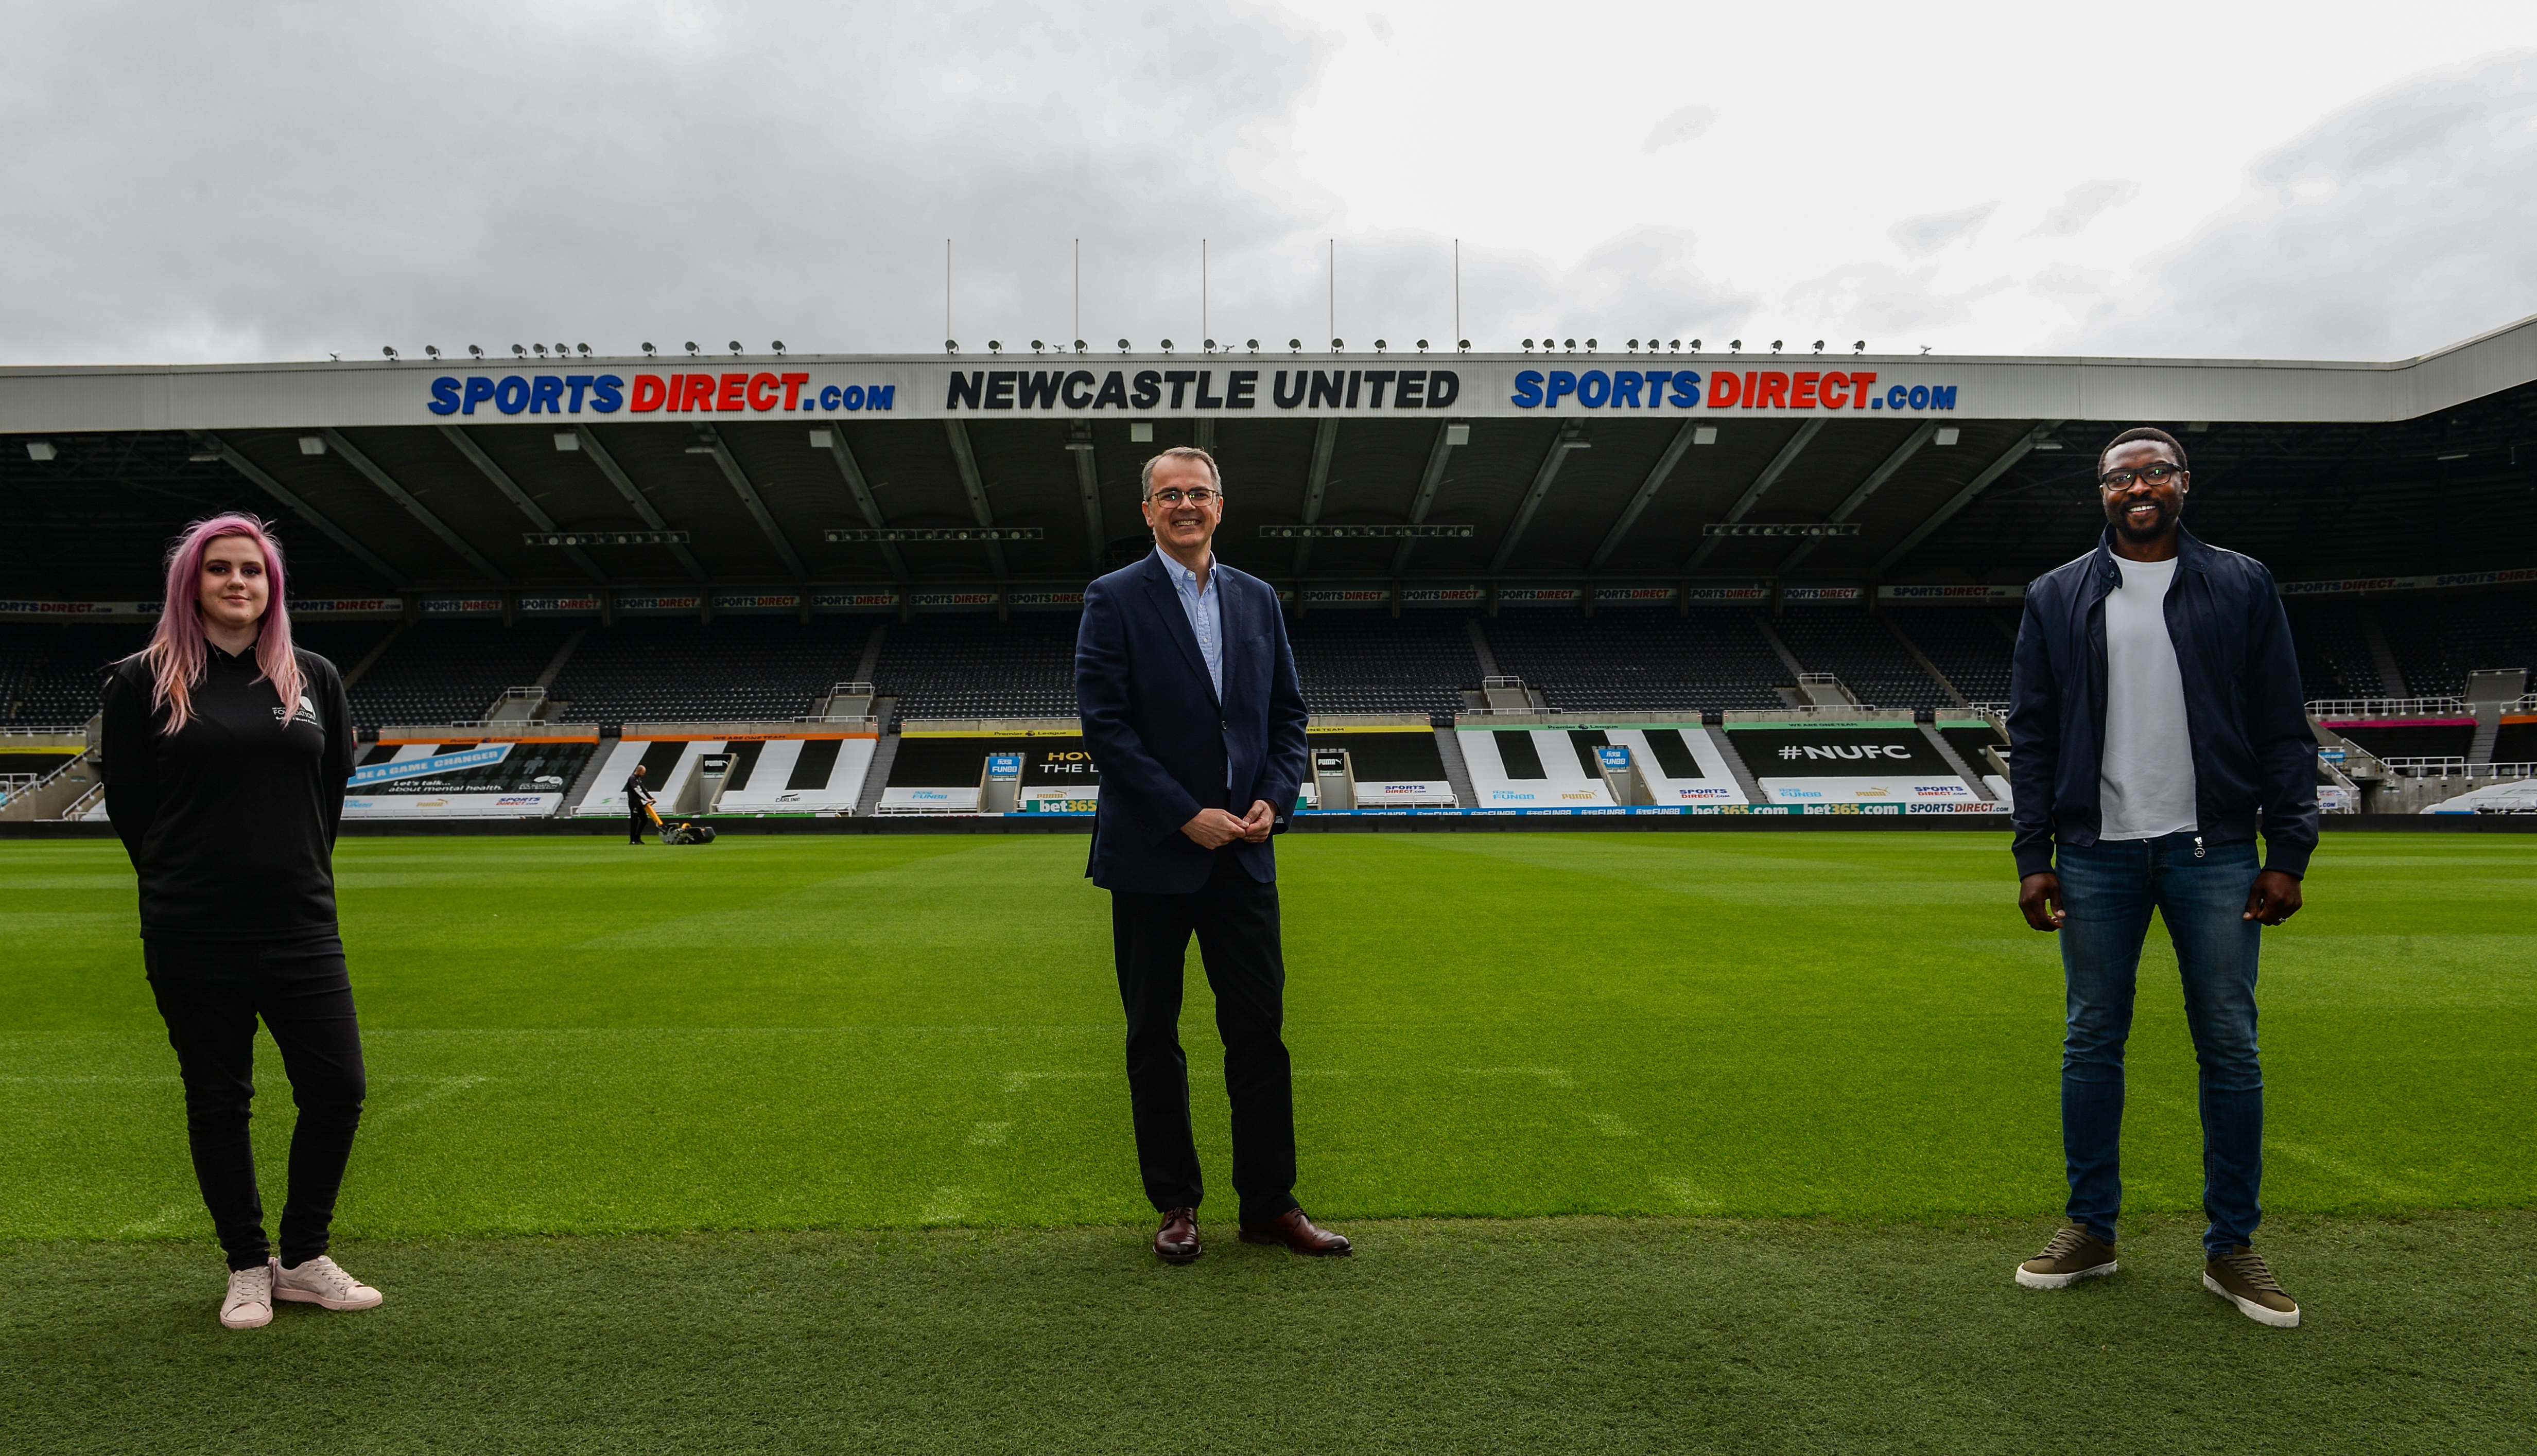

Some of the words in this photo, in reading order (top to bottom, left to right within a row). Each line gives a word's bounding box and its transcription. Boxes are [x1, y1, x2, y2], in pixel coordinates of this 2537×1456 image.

[946, 370, 1258, 409] NEWCASTLE
[1273, 370, 1460, 409] UNITED
[2436, 570, 2537, 586] SPORTSDIRE
[1009, 593, 1084, 603] SPORTSDIREC
[1048, 751, 1092, 761] HO
[1778, 745, 1912, 760] #NUFC
[357, 770, 374, 780] BE
[376, 768, 387, 777] A
[389, 762, 428, 775] GAME
[434, 750, 498, 768] CHANGER
[1039, 764, 1083, 773] THE
[1039, 800, 1096, 812] bet365
[1692, 805, 1788, 815] bet365.com
[1803, 803, 1899, 815] bet365.com
